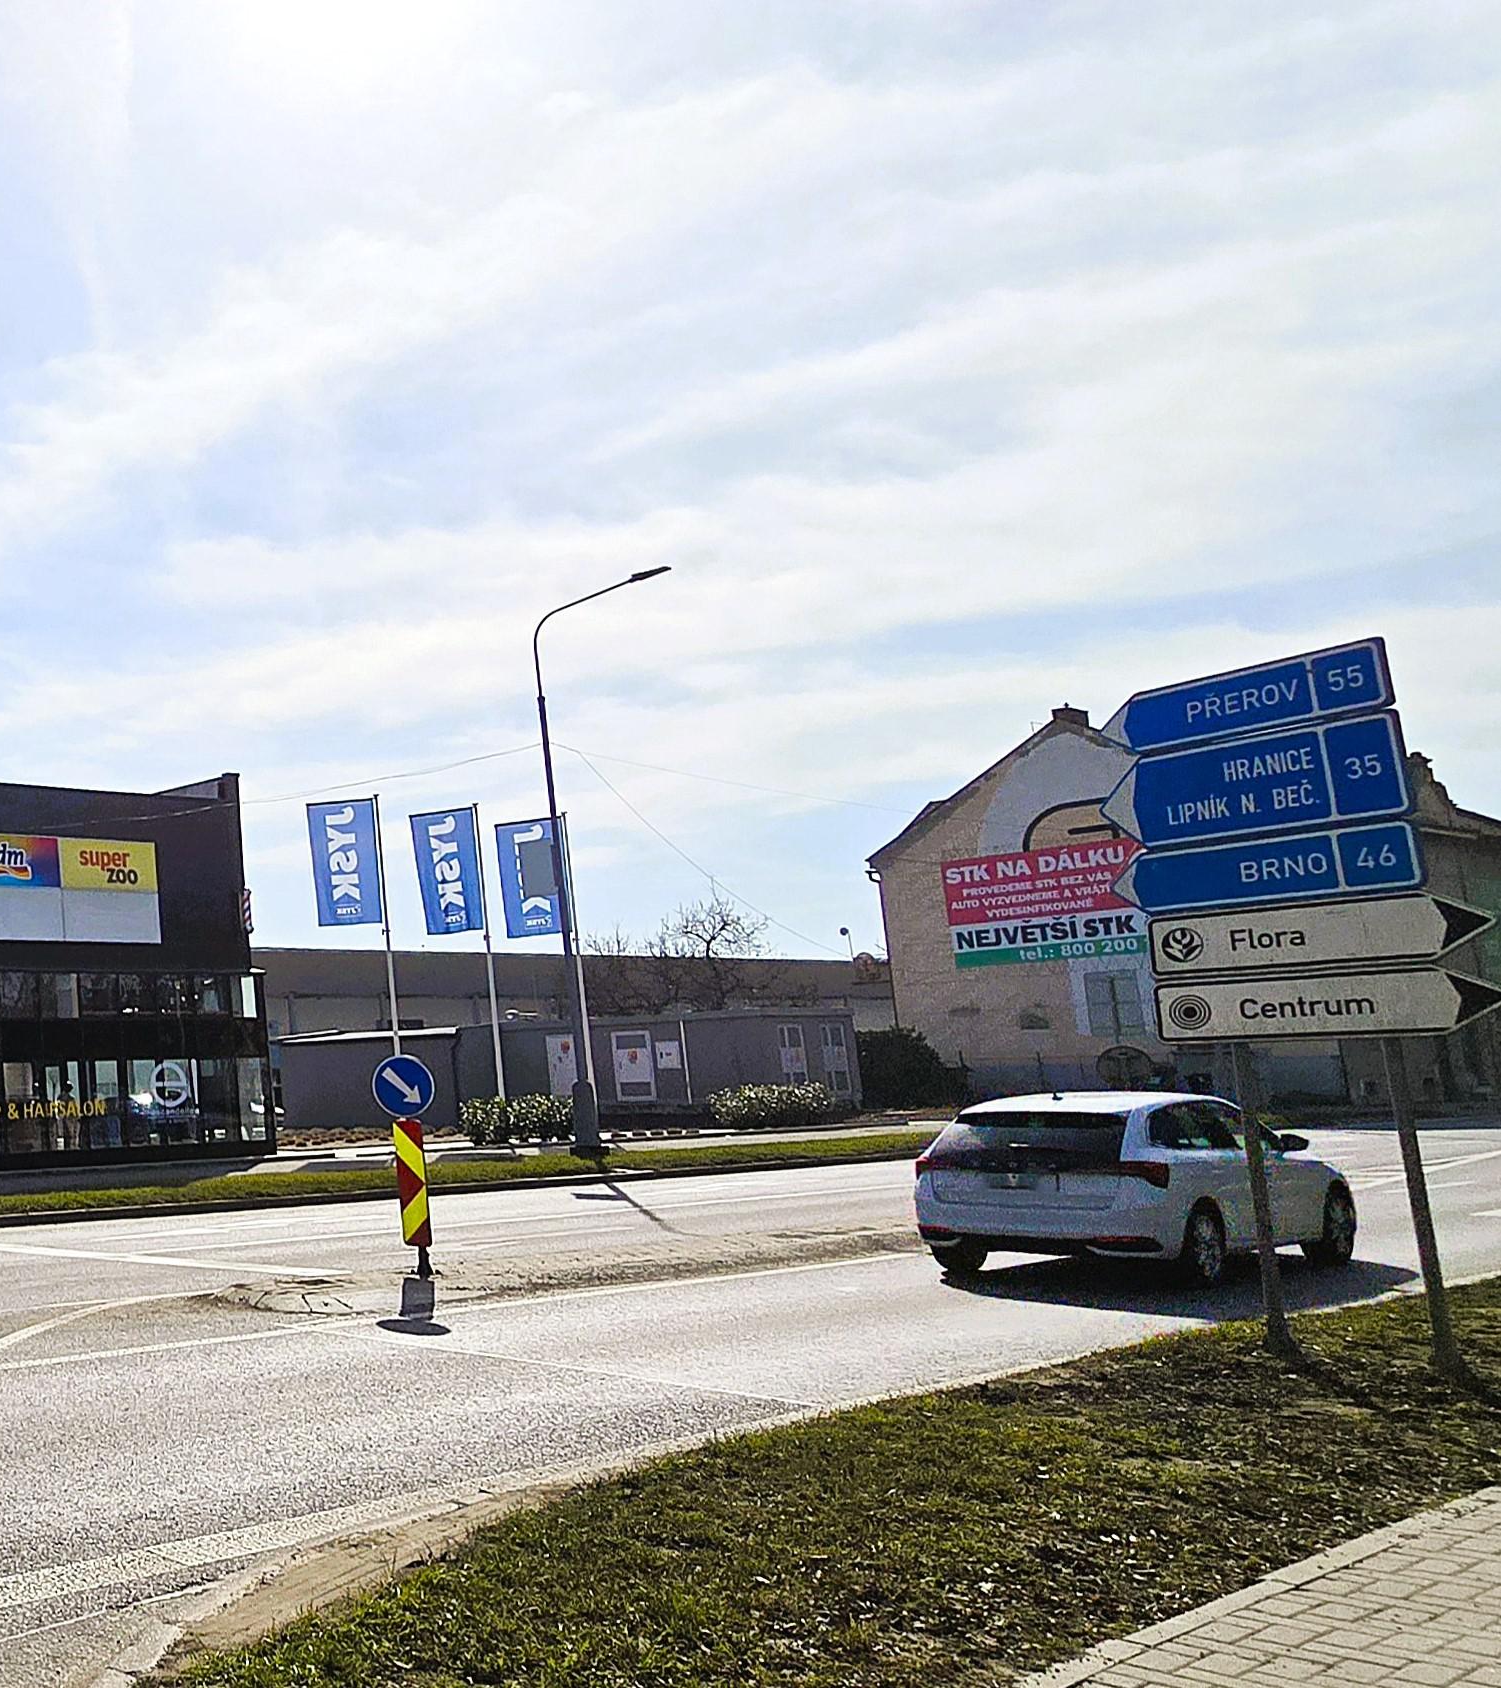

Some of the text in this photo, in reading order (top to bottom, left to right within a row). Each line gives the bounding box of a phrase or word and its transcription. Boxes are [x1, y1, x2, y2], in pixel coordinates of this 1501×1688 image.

[1327, 665, 1364, 692] 55
[1186, 679, 1298, 723] PŘEROV
[1223, 747, 1315, 782] HRANICE
[1344, 754, 1382, 780] 35
[1166, 779, 1320, 826] LIPNÍK N. BEČ.
[80, 850, 130, 871] super
[946, 846, 1125, 884] STK NA DÁLKU
[1239, 853, 1328, 883] BRNO
[1357, 844, 1397, 869] 46
[963, 871, 1112, 897] PROVEDEME STK BEZ VÁS
[951, 899, 980, 910] AUTO
[984, 890, 1060, 906] VYZVEDNEME
[1063, 889, 1072, 898] A
[985, 898, 1094, 918] VYDESINFIKOVANÉ
[956, 915, 1138, 950] NEJVĚTŠÍ STK
[1229, 929, 1306, 951] Flora
[1019, 938, 1138, 961] tel.: 800 200
[1239, 996, 1376, 1020] Centrum
[7, 1102, 20, 1120] &
